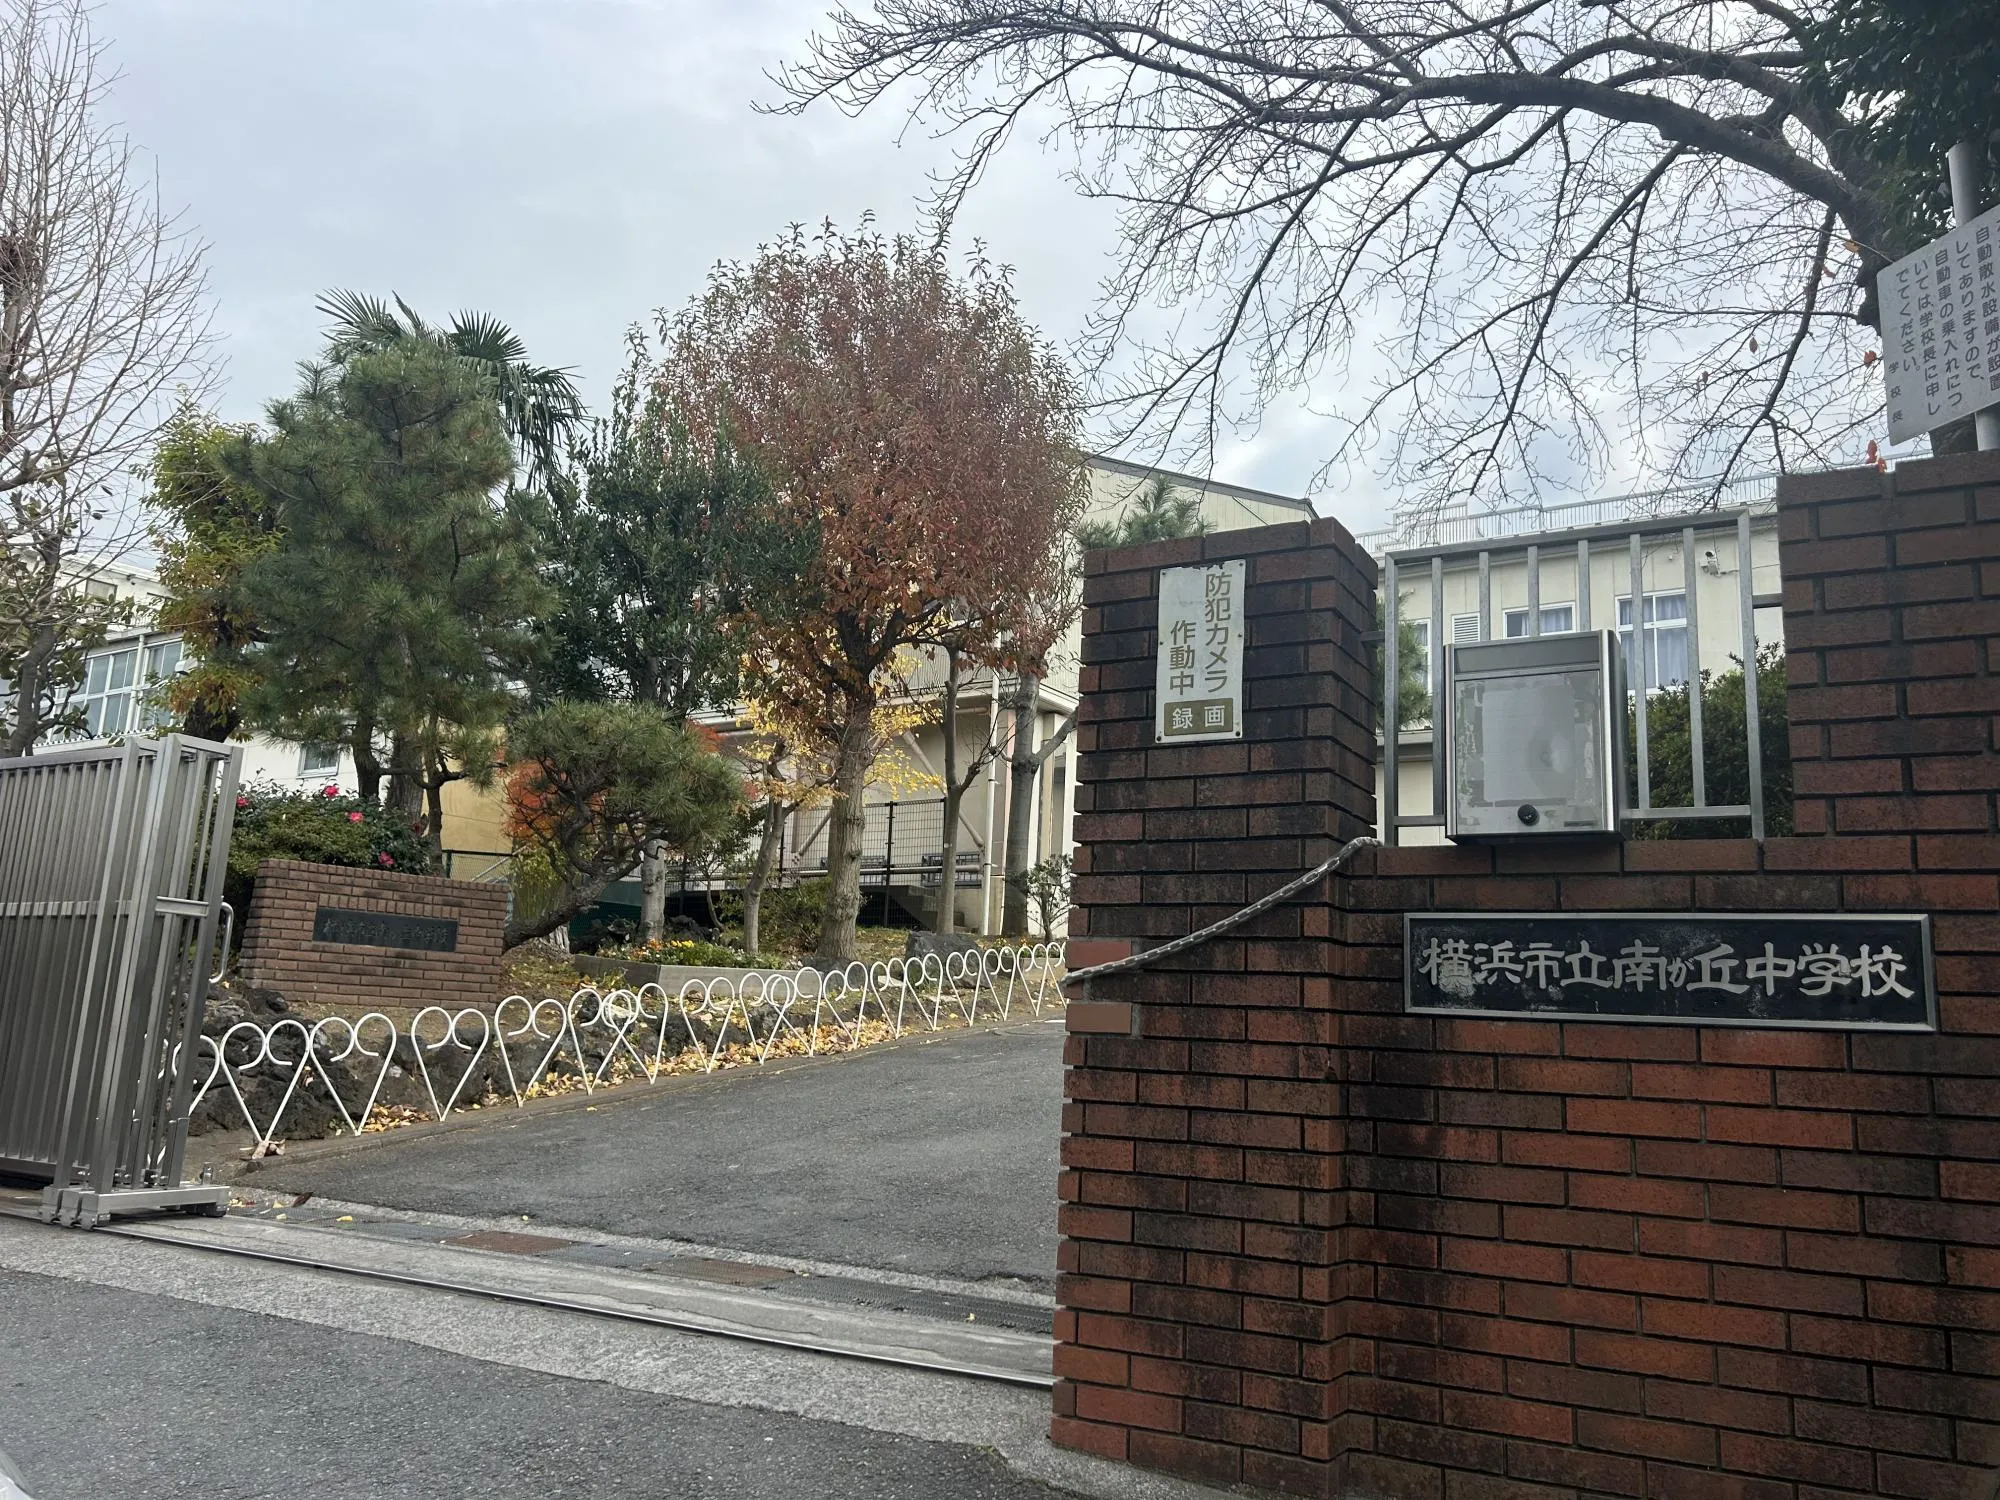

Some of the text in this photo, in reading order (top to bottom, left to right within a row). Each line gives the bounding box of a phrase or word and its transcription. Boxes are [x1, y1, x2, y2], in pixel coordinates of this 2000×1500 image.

[1896, 268, 1920, 372] でてください。
[1914, 259, 1941, 416] いては、学校長に申し
[1935, 248, 1962, 407] 自動車の乗入れにつ
[1956, 240, 1984, 379] してありますので、
[1888, 361, 1903, 423] 学校長
[1169, 619, 1197, 695] 作動中
[1204, 571, 1232, 693] 防犯カメラ
[1172, 705, 1225, 729] 録画
[1418, 937, 1915, 998] 横浜市立南が丘中学校
